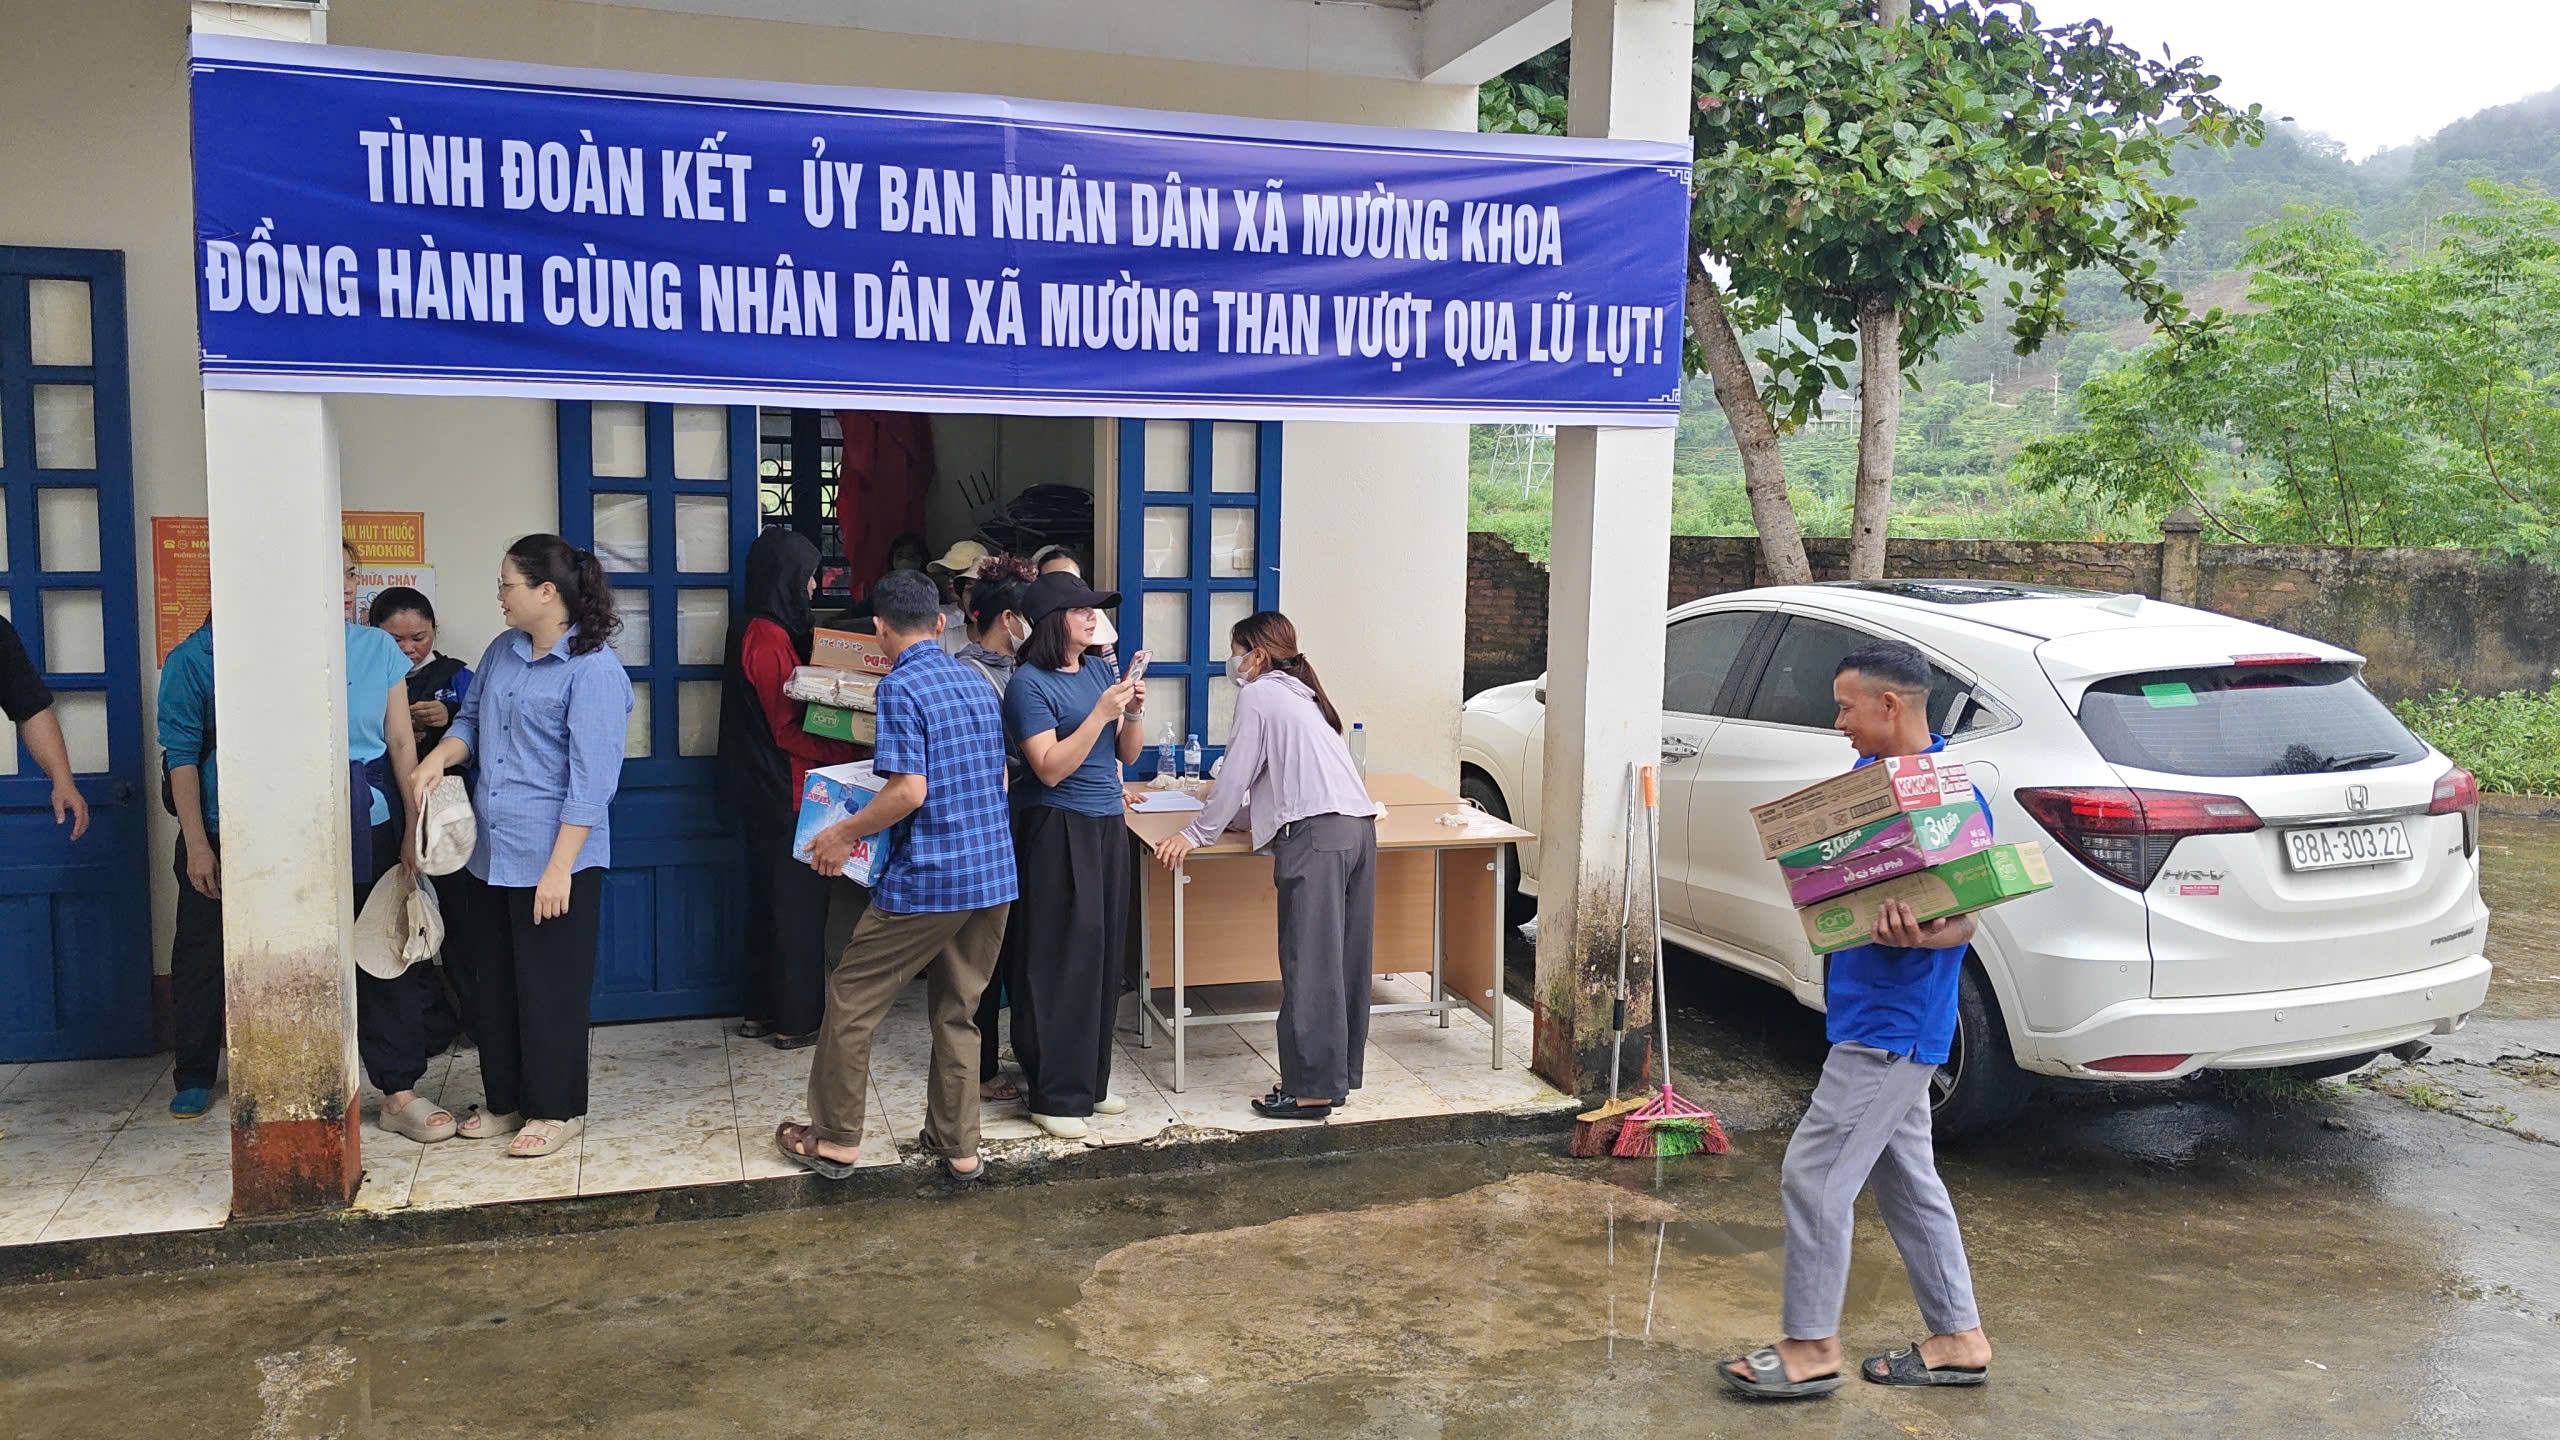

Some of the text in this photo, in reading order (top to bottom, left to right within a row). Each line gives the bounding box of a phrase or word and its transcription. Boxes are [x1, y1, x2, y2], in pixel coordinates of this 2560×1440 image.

[359, 117, 483, 208] TÌNH
[501, 130, 645, 217] ĐOÀN
[661, 131, 752, 222] KẾT
[803, 136, 863, 230] ỦY
[880, 167, 975, 237] BAN
[992, 164, 1116, 242] NHÂN
[1131, 172, 1219, 250] DÂN
[1234, 179, 1288, 254] XÃ
[1302, 182, 1448, 262] MƯỜNG
[1461, 202, 1563, 266] KHOA
[205, 217, 1664, 377] ĐỒNG HÀNH CÙNG NHÂN DÂN XÃ MƯỜNG THAN VƯỢT QUA LŨ LỤT!
[359, 521, 379, 540] HÚT
[382, 520, 415, 540] THUỐC
[357, 544, 415, 558] SMOKING
[2292, 825, 2407, 864] 88A-303.22
